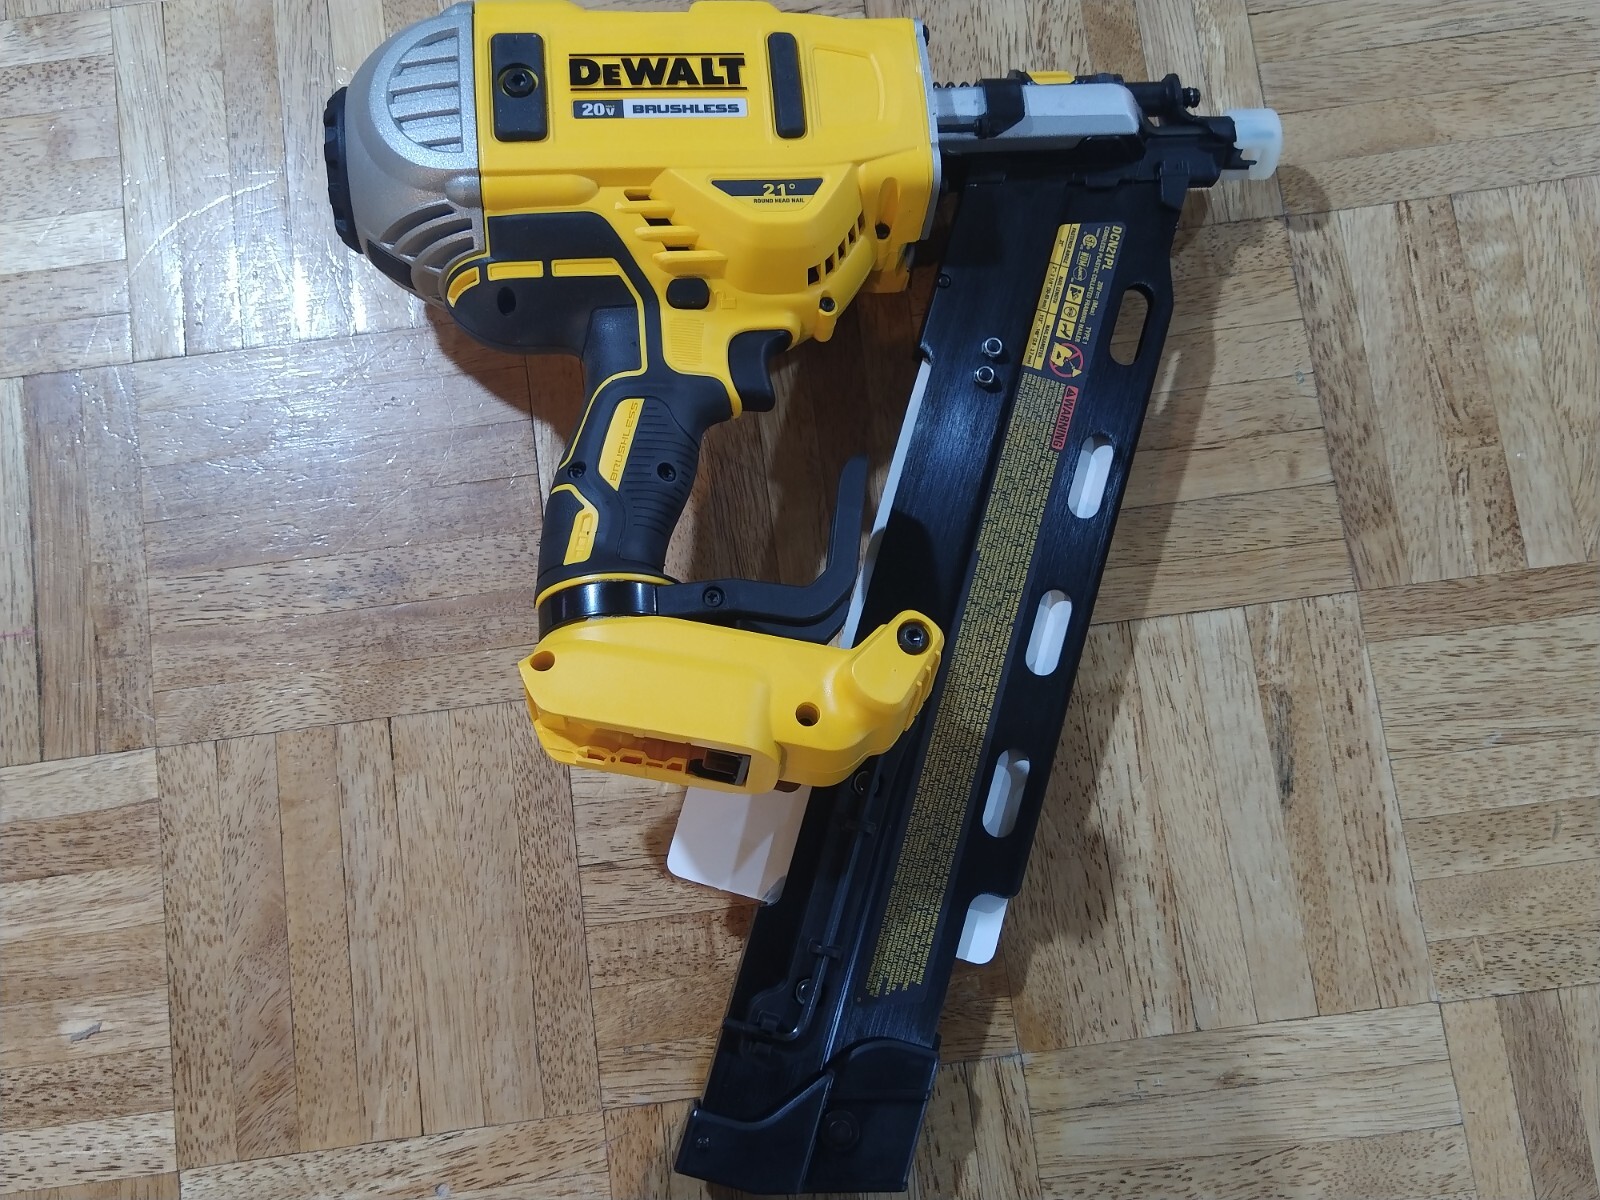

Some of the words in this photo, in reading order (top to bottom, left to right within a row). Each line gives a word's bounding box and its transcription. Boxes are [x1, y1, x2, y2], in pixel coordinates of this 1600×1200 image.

[632, 104, 739, 114] BRUSHLESS
[1101, 225, 1122, 271] DCN21PL
[1092, 251, 1103, 273] PLASTIC
[1085, 273, 1097, 298] COLLATED
[1079, 298, 1090, 323] FRAMING
[1074, 323, 1084, 343] NAILER
[1082, 326, 1091, 341] TYPE
[1052, 397, 1074, 447] WARNING
[609, 402, 639, 482] BRUSHLESS
